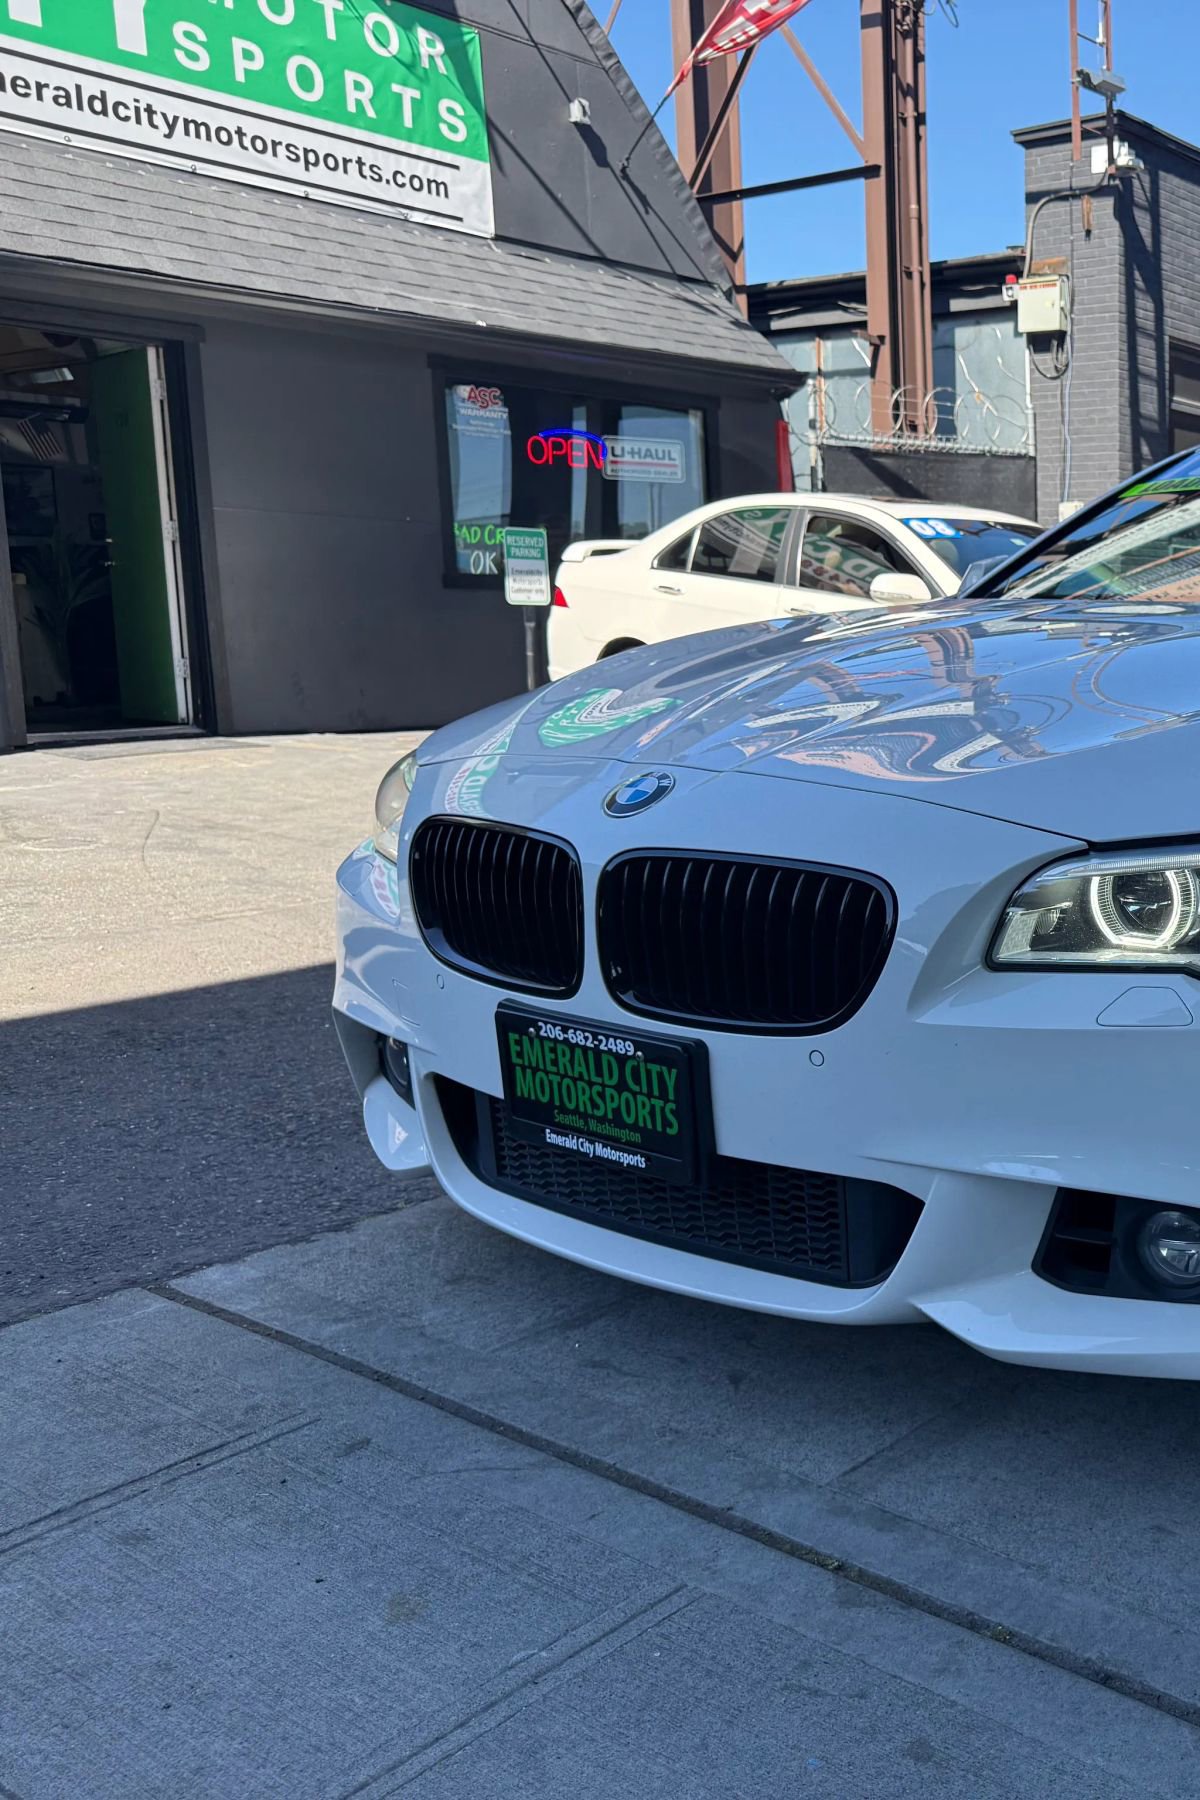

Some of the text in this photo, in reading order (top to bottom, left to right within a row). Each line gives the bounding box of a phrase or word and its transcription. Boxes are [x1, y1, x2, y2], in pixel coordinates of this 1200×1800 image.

[209, 0, 446, 74] OTOR
[172, 20, 468, 143] SPORTS
[0, 70, 450, 199] eraldcitymotorsports.com
[466, 384, 501, 410] ASC
[527, 435, 603, 470] OPEN
[611, 445, 677, 461] U-HAUL
[506, 535, 544, 548] RESERVED
[909, 519, 956, 537] 08
[470, 550, 498, 575] OK
[511, 547, 541, 558] PARKING
[538, 1022, 635, 1056] 206-682-2489
[508, 1032, 678, 1100] EMERALD CITY
[515, 1067, 679, 1136] MOTORSPORTS
[554, 1109, 641, 1143] Seattle, Washington
[545, 1128, 646, 1168] Emerald City Motorsports
